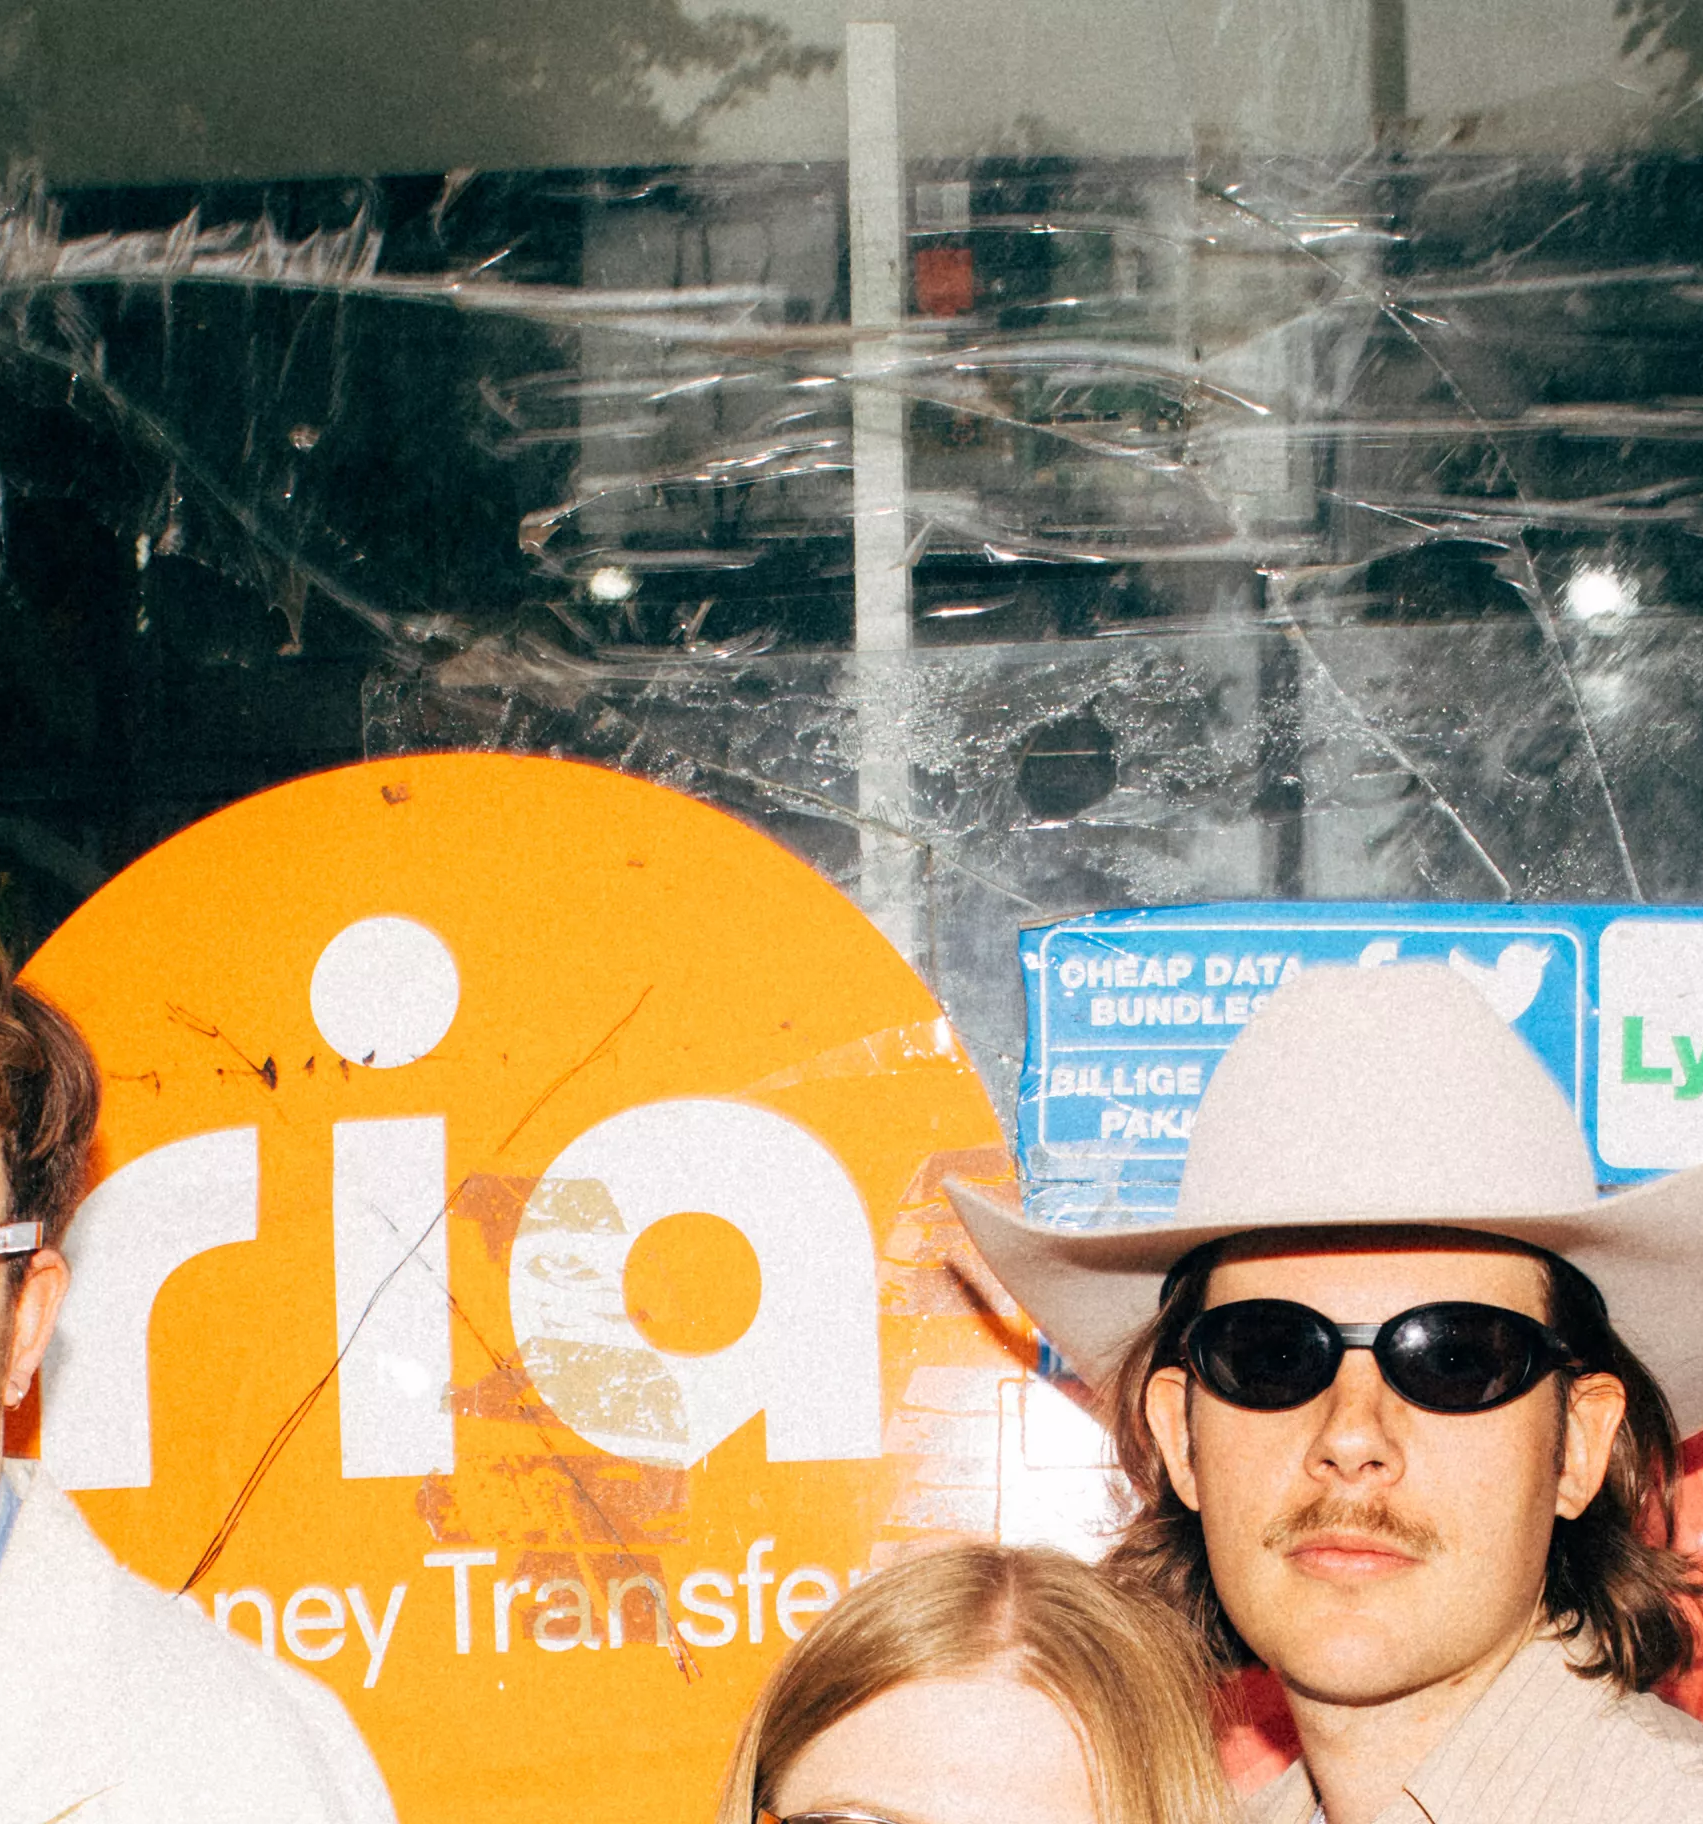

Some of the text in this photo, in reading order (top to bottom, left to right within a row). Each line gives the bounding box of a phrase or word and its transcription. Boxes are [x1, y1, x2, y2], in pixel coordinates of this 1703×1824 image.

[1059, 956, 1301, 988] CHEAP DATA
[1050, 1067, 1203, 1097] BILLIGE
[41, 916, 883, 1491] ria
